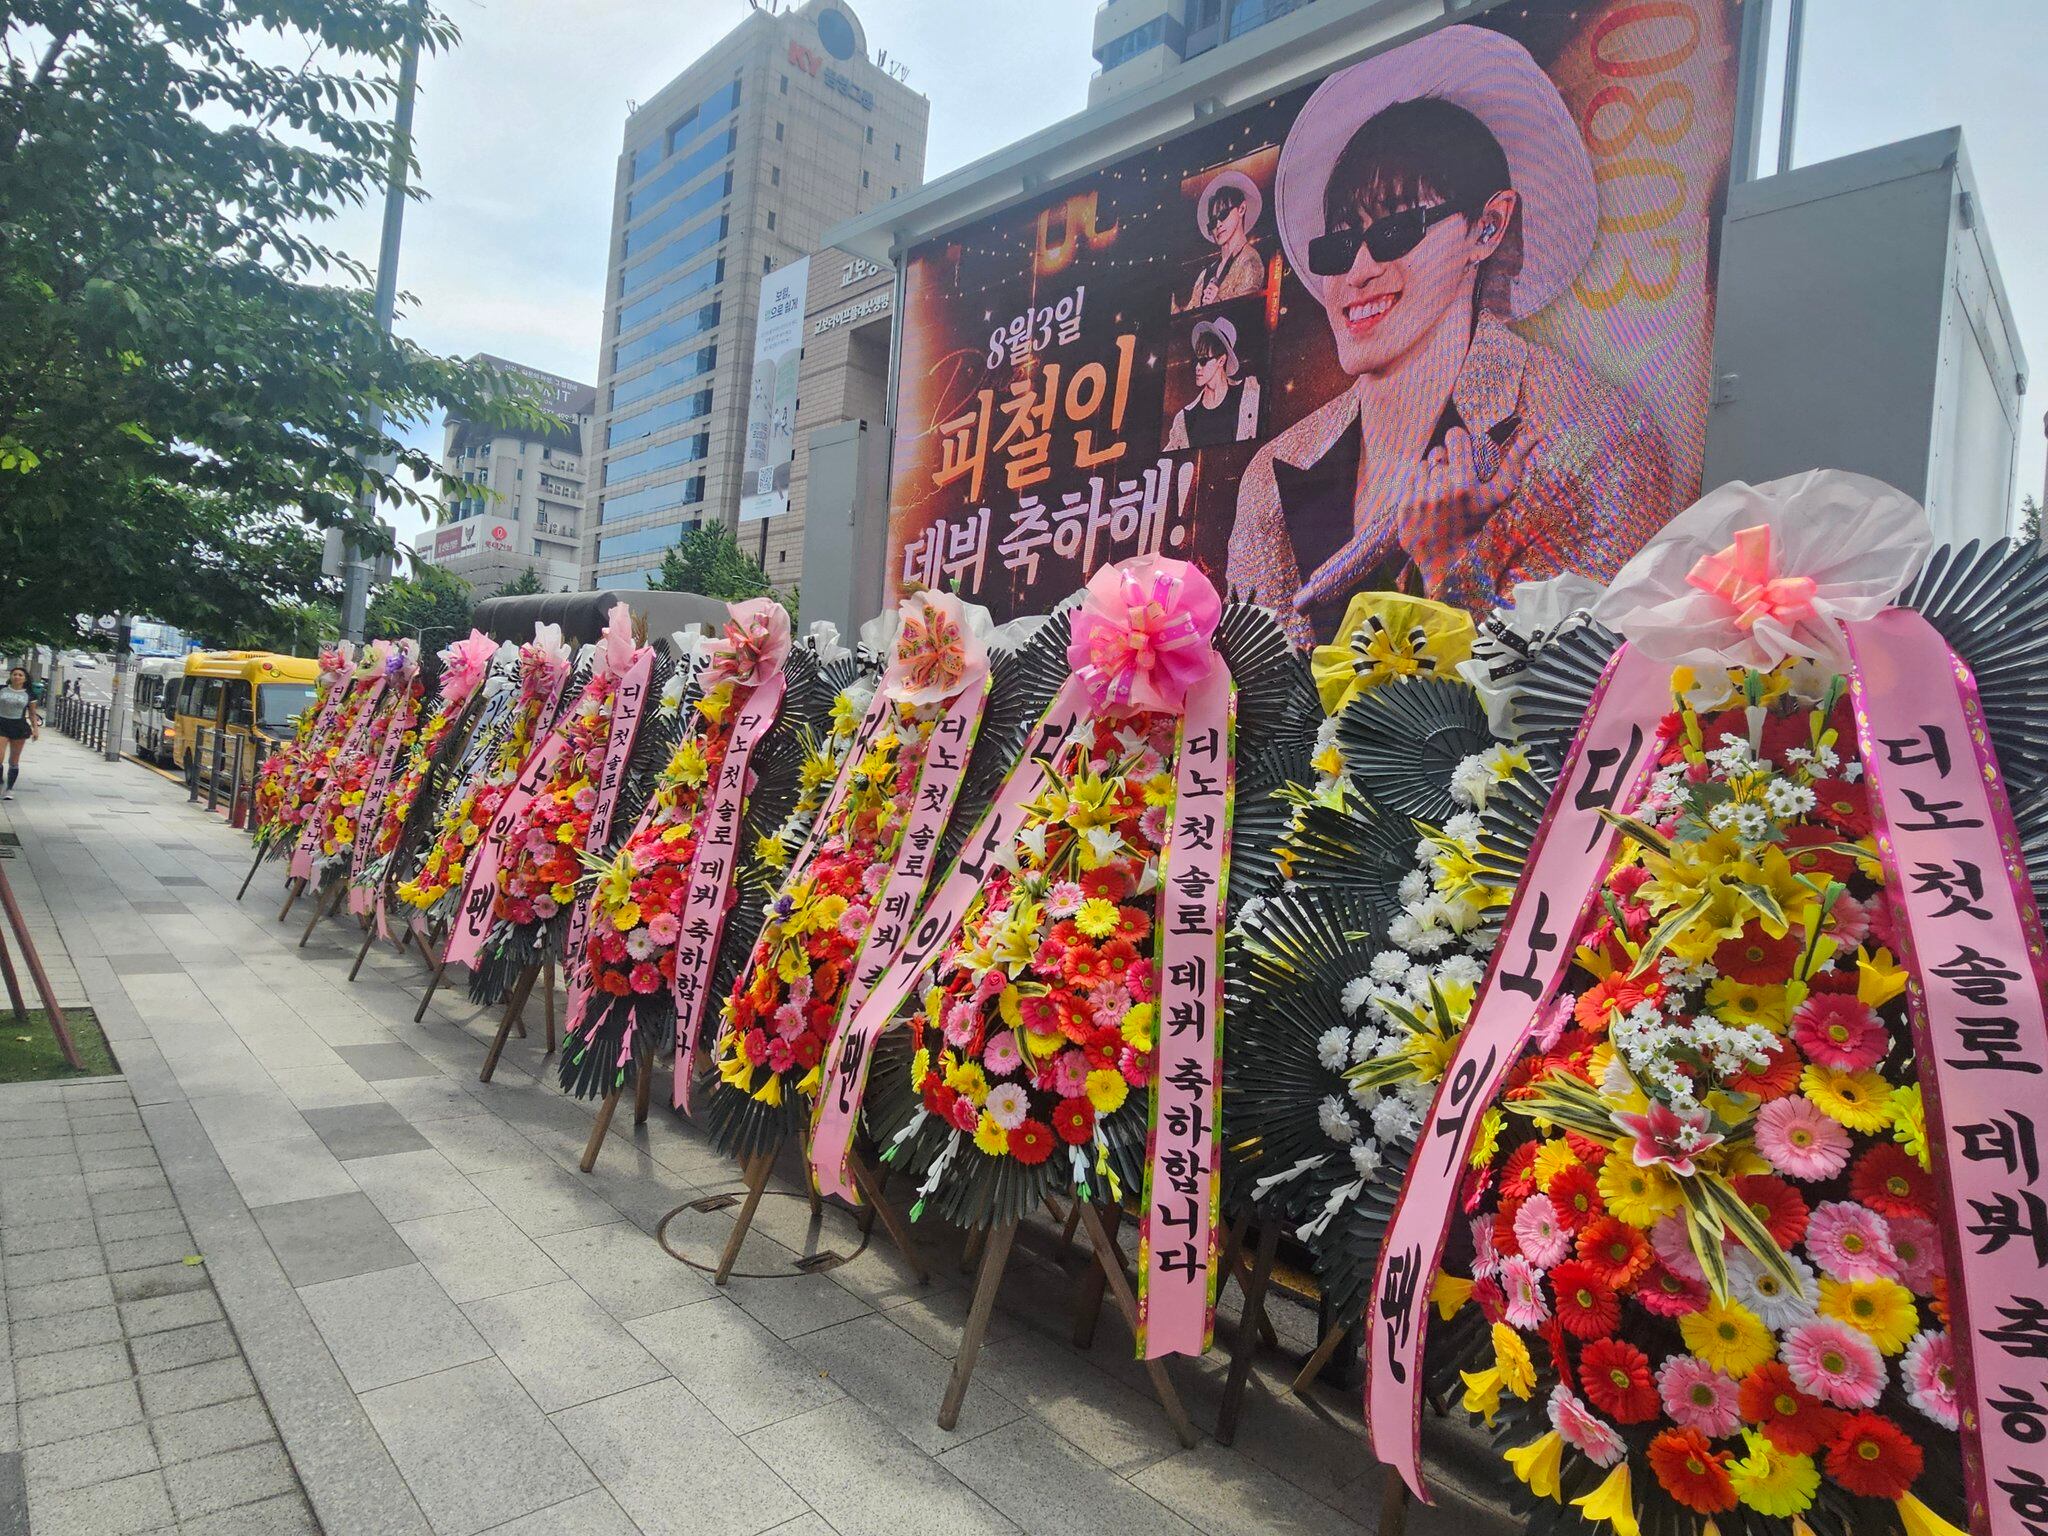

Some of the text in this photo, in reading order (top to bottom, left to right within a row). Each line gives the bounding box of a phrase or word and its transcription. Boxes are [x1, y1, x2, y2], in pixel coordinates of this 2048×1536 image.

[987, 286, 1086, 371] 8월3일
[931, 334, 1137, 502] 피철인
[903, 458, 1195, 594] 데뷔 축하해!
[613, 727, 630, 750] 첫
[617, 686, 640, 721] 디노
[730, 713, 762, 754] 디노
[602, 754, 622, 792] 솔로
[722, 765, 741, 789] 첫
[1877, 724, 2005, 832] 디노
[590, 798, 612, 840] 데뷔
[708, 799, 737, 846] 솔로
[872, 715, 967, 956] 디노 첫 솔로 데뷔
[466, 881, 495, 937] 팬
[692, 858, 725, 911] 데뷔
[1909, 859, 1994, 921] 첫
[1158, 727, 1224, 1287] 디노 첫 솔로 데뷔 축하합니다
[1928, 944, 2044, 1075] 솔로
[838, 1026, 868, 1115] 팬
[1379, 722, 1643, 1386] 디노의 팬
[1952, 1108, 2048, 1270] 데뷔
